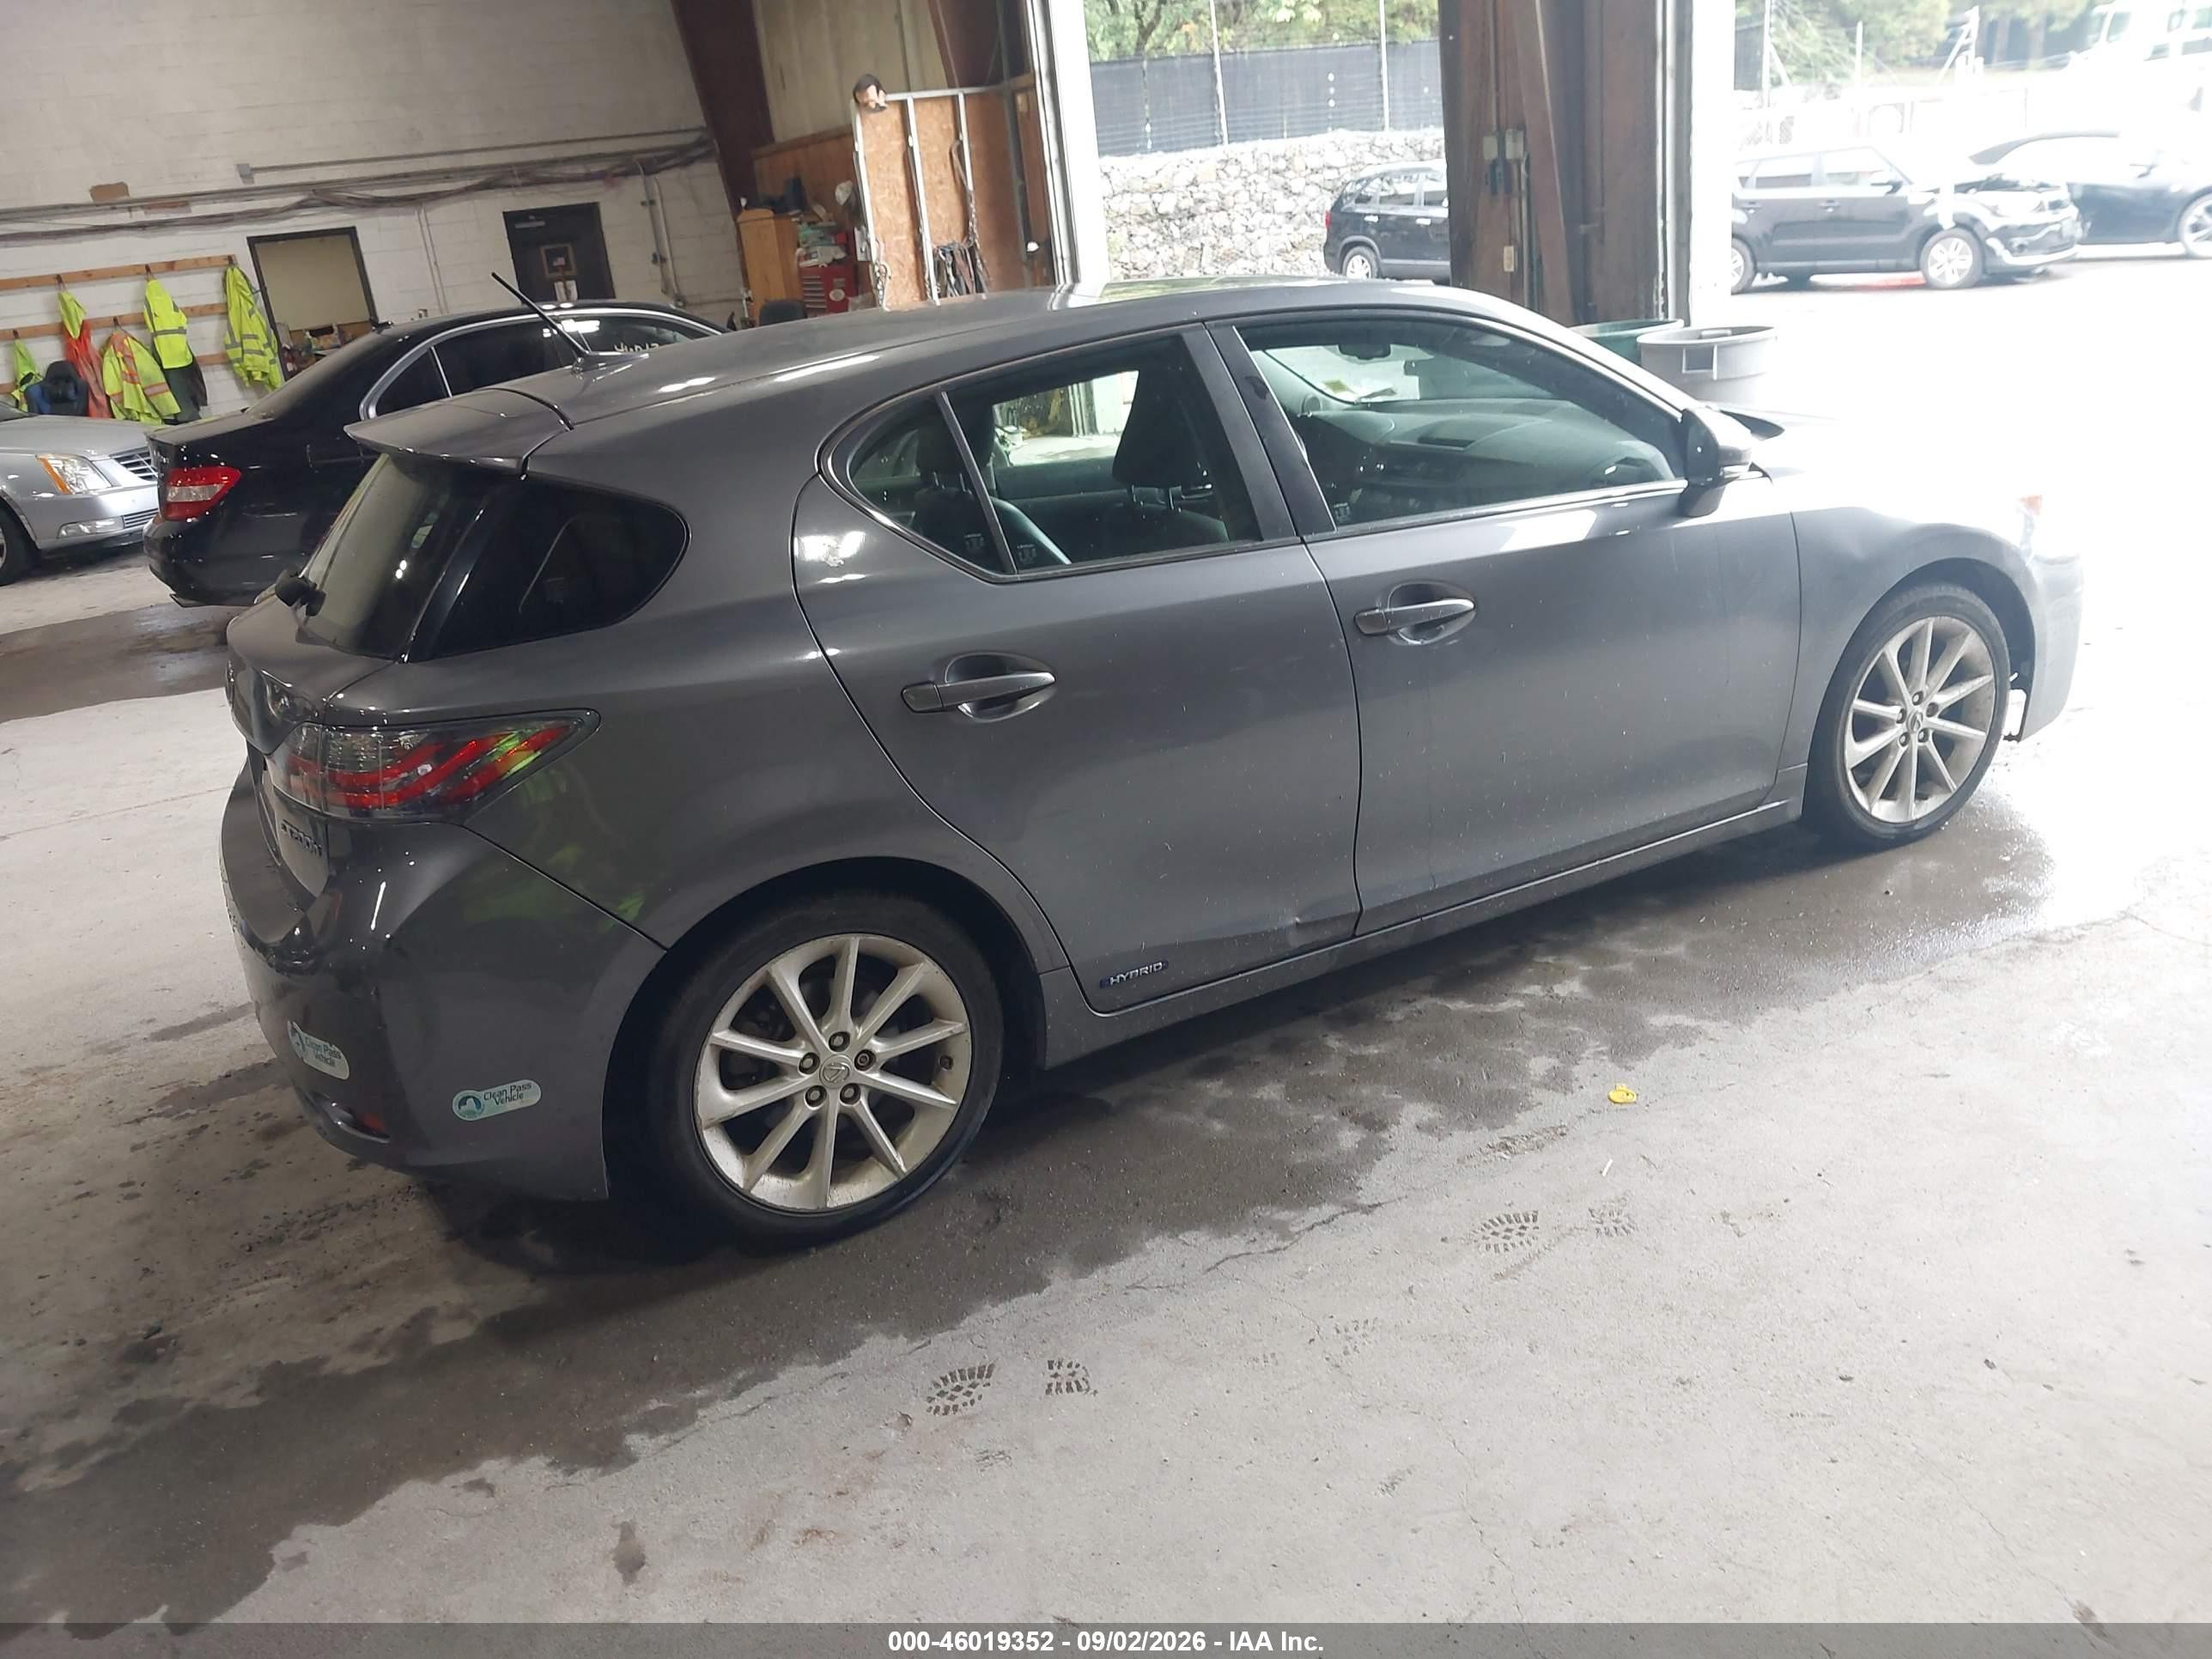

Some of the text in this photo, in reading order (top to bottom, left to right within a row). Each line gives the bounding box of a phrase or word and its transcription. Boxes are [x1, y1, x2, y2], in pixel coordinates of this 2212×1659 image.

[1109, 962, 1163, 985] HYBRID
[323, 1042, 342, 1060] Pass
[483, 1082, 532, 1101] Clean Pass
[494, 1091, 524, 1106] Vehicle
